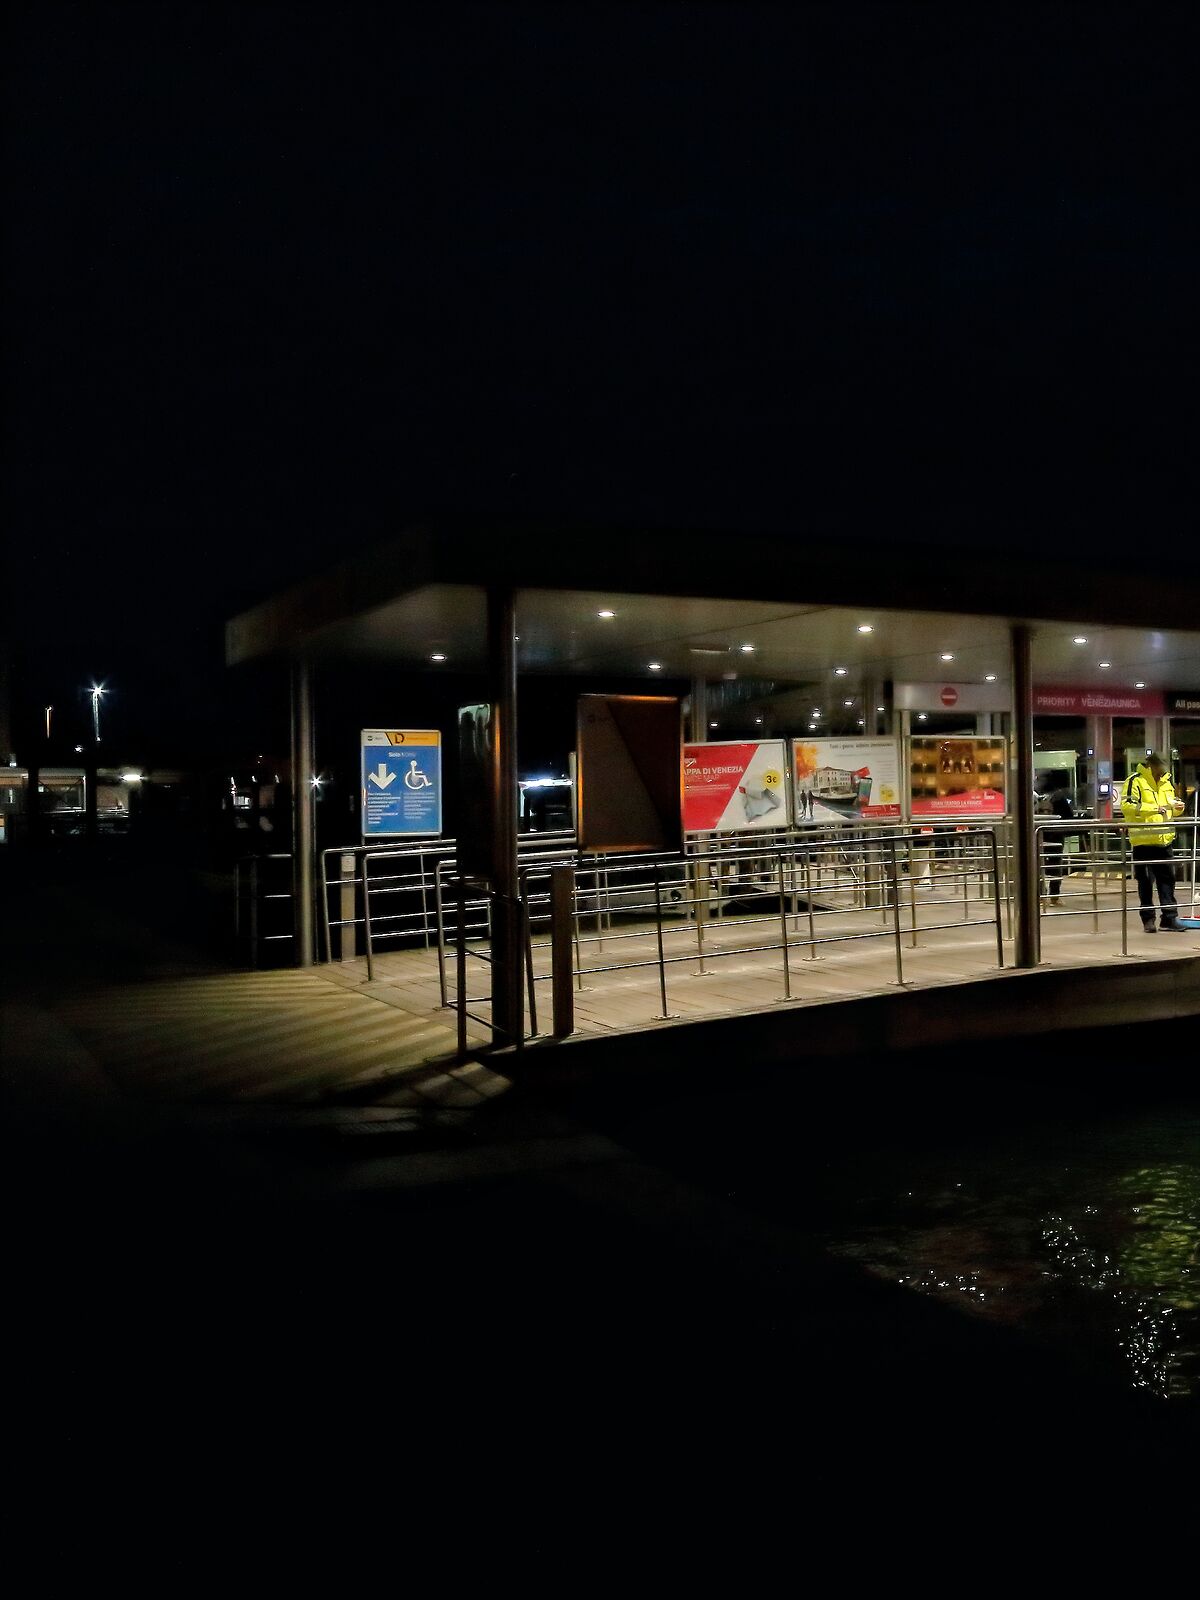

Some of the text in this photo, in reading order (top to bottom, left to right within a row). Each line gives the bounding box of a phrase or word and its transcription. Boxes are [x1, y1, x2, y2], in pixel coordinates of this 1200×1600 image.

[1037, 696, 1076, 705] PRIORITY
[1175, 699, 1186, 708] All
[703, 766, 711, 775] DI
[712, 765, 744, 775] VENEZIA
